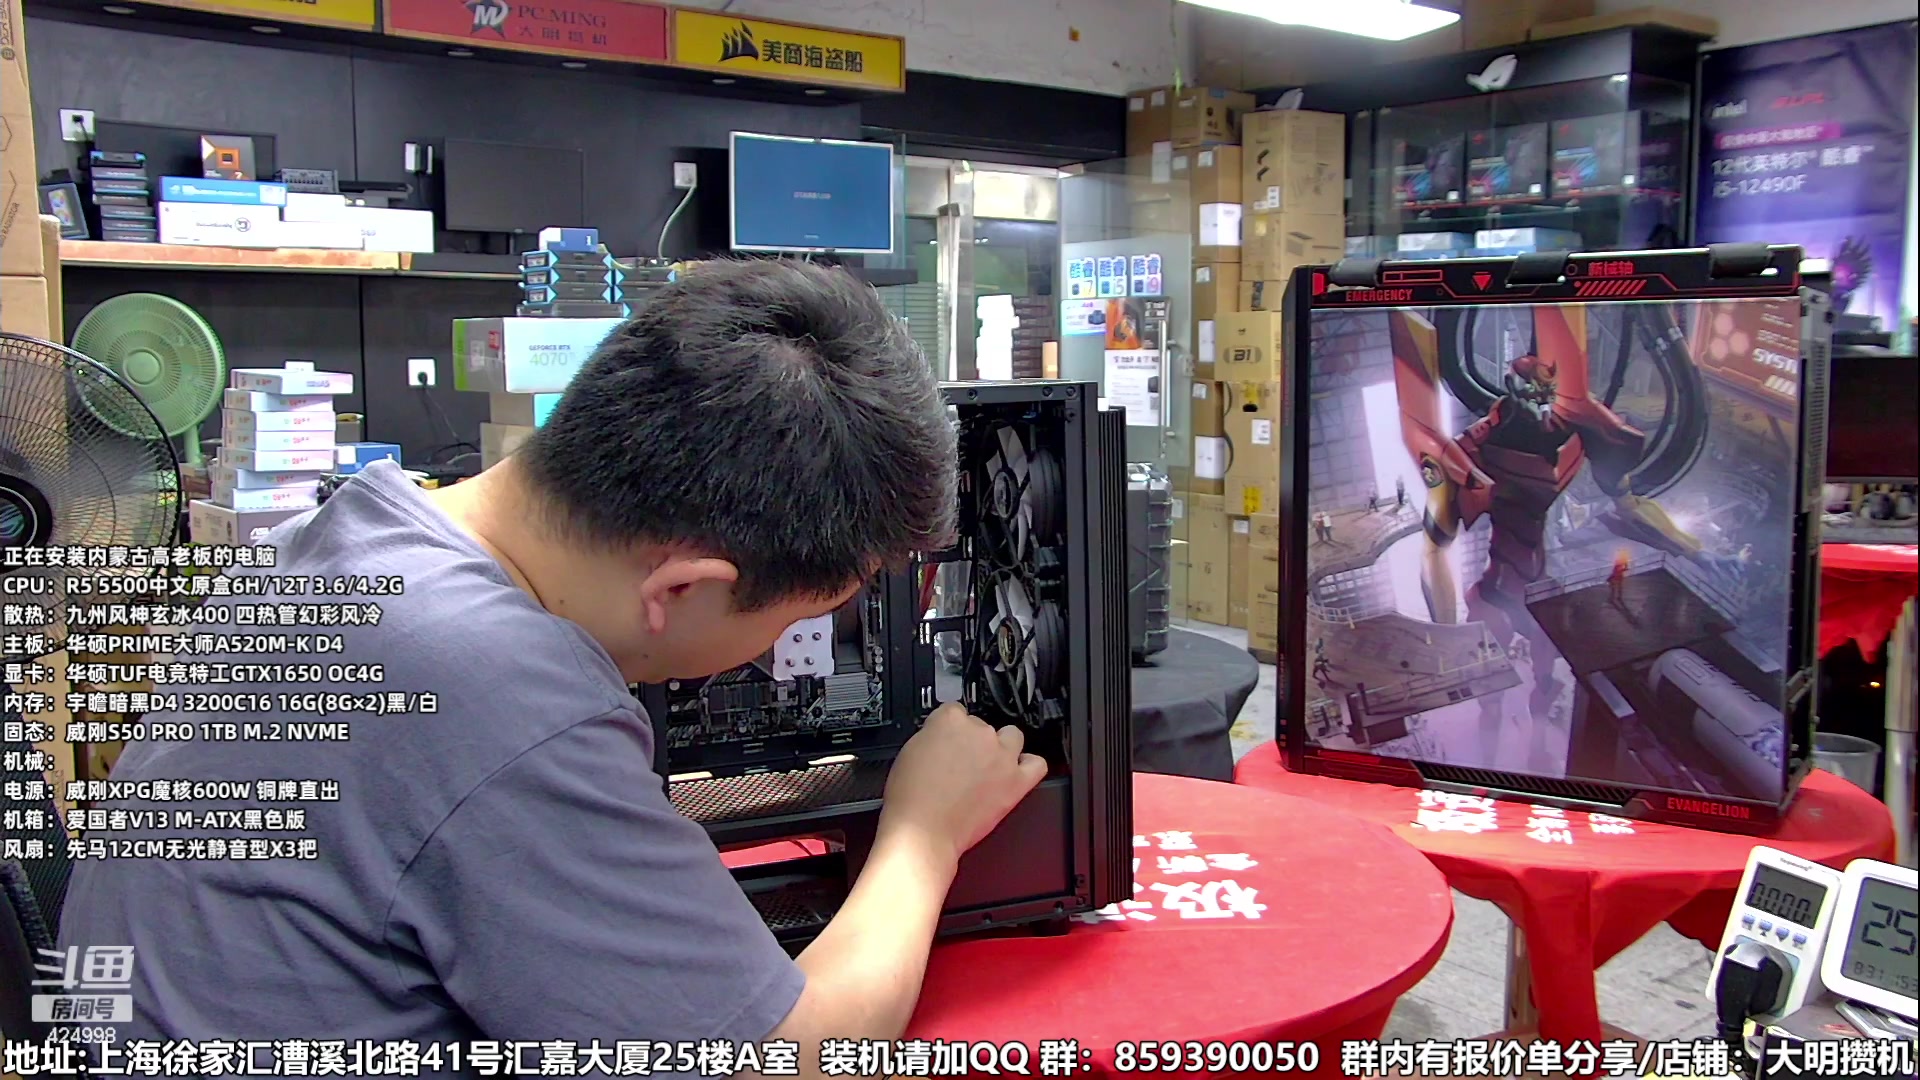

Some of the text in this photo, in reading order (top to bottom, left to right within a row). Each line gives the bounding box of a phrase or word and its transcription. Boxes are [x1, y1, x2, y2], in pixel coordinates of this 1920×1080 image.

[762, 39, 863, 72] 美商海盗船
[1712, 174, 1808, 198] i5-12490F
[1345, 288, 1413, 302] EMERGENCY
[529, 352, 569, 366] 4070
[1667, 797, 1750, 819] EVANGELION
